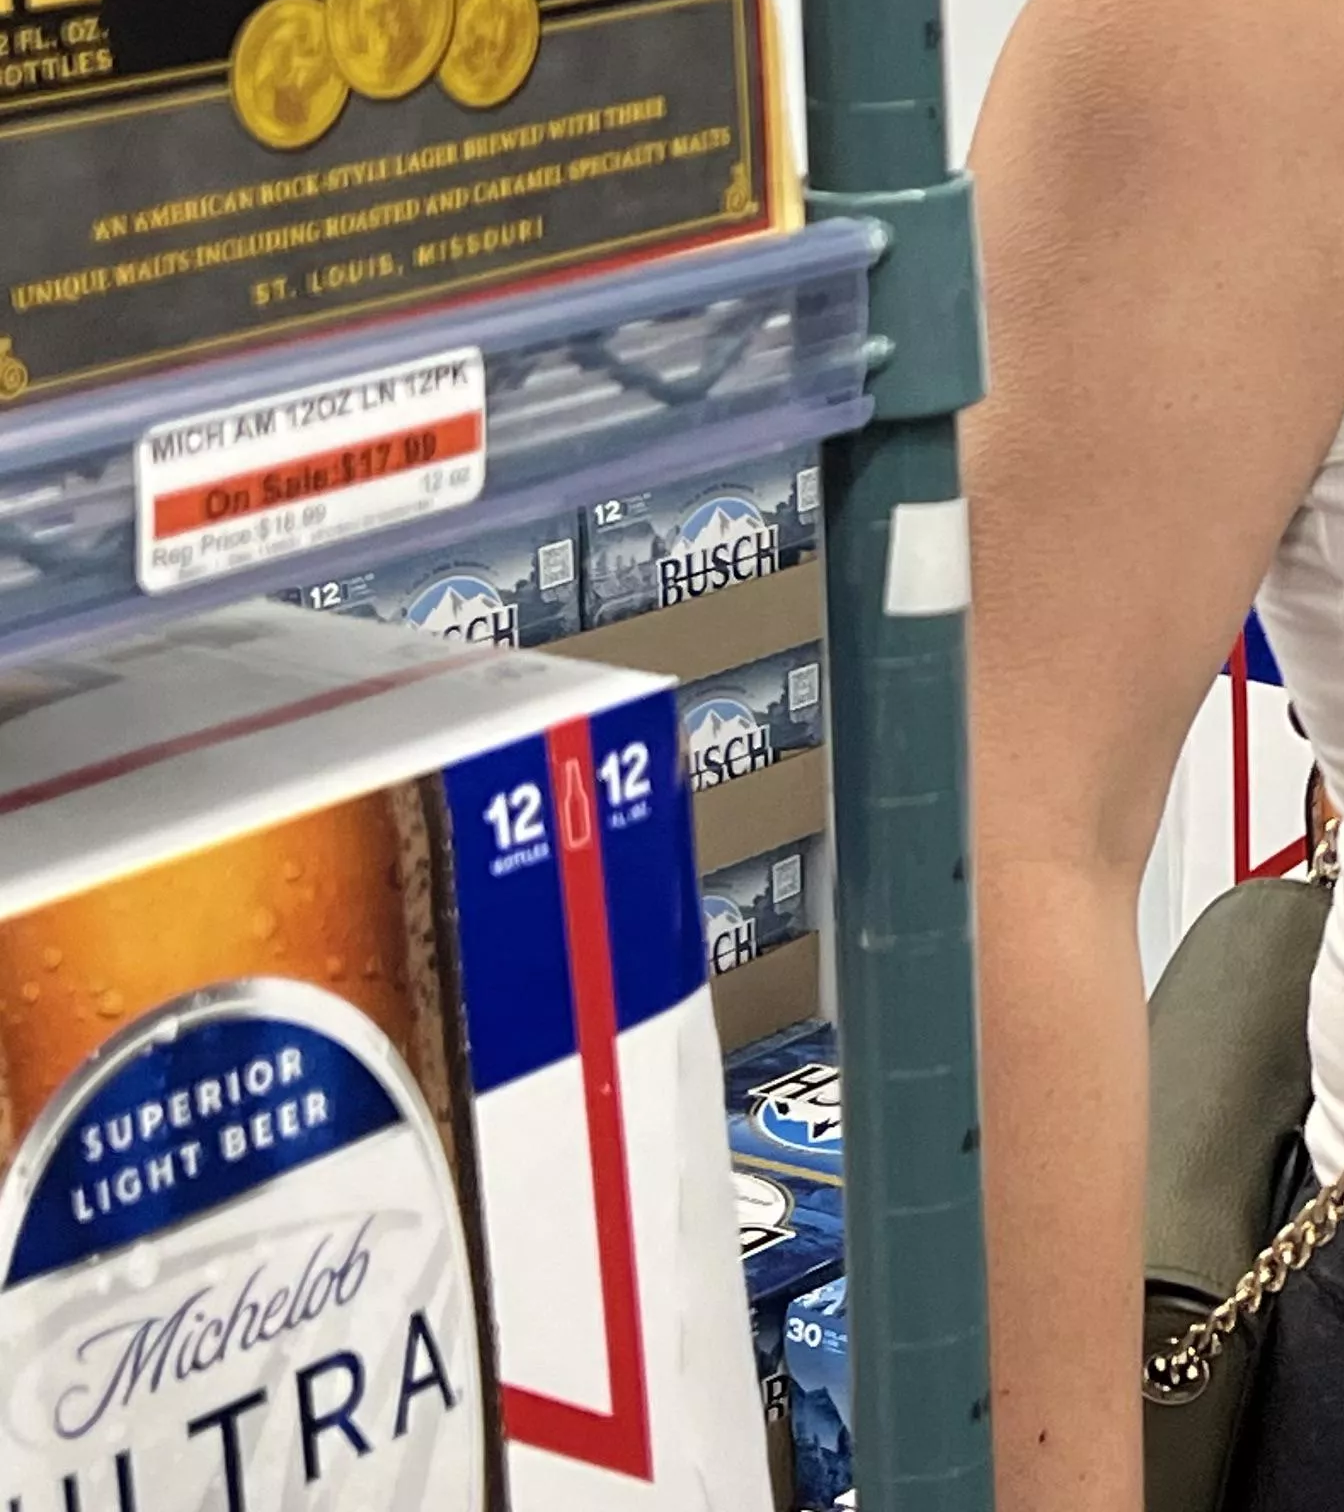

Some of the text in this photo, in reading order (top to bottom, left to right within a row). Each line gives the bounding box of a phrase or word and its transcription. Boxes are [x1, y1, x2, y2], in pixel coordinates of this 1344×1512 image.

[411, 218, 546, 268] MISSOURI
[14, 271, 112, 312] UNIQUE
[151, 362, 469, 465] MICH AM 12OZ LN 12PK
[204, 486, 252, 521] On
[594, 499, 623, 526] 12
[310, 582, 341, 609] 12
[656, 523, 780, 608] BUSCH
[598, 742, 652, 806] 12
[484, 783, 546, 850] 12
[80, 1047, 305, 1163] SUPERIOR
[70, 1090, 329, 1225] LIGHT BEER
[53, 1213, 377, 1441] Michelob
[786, 1317, 823, 1348] 30
